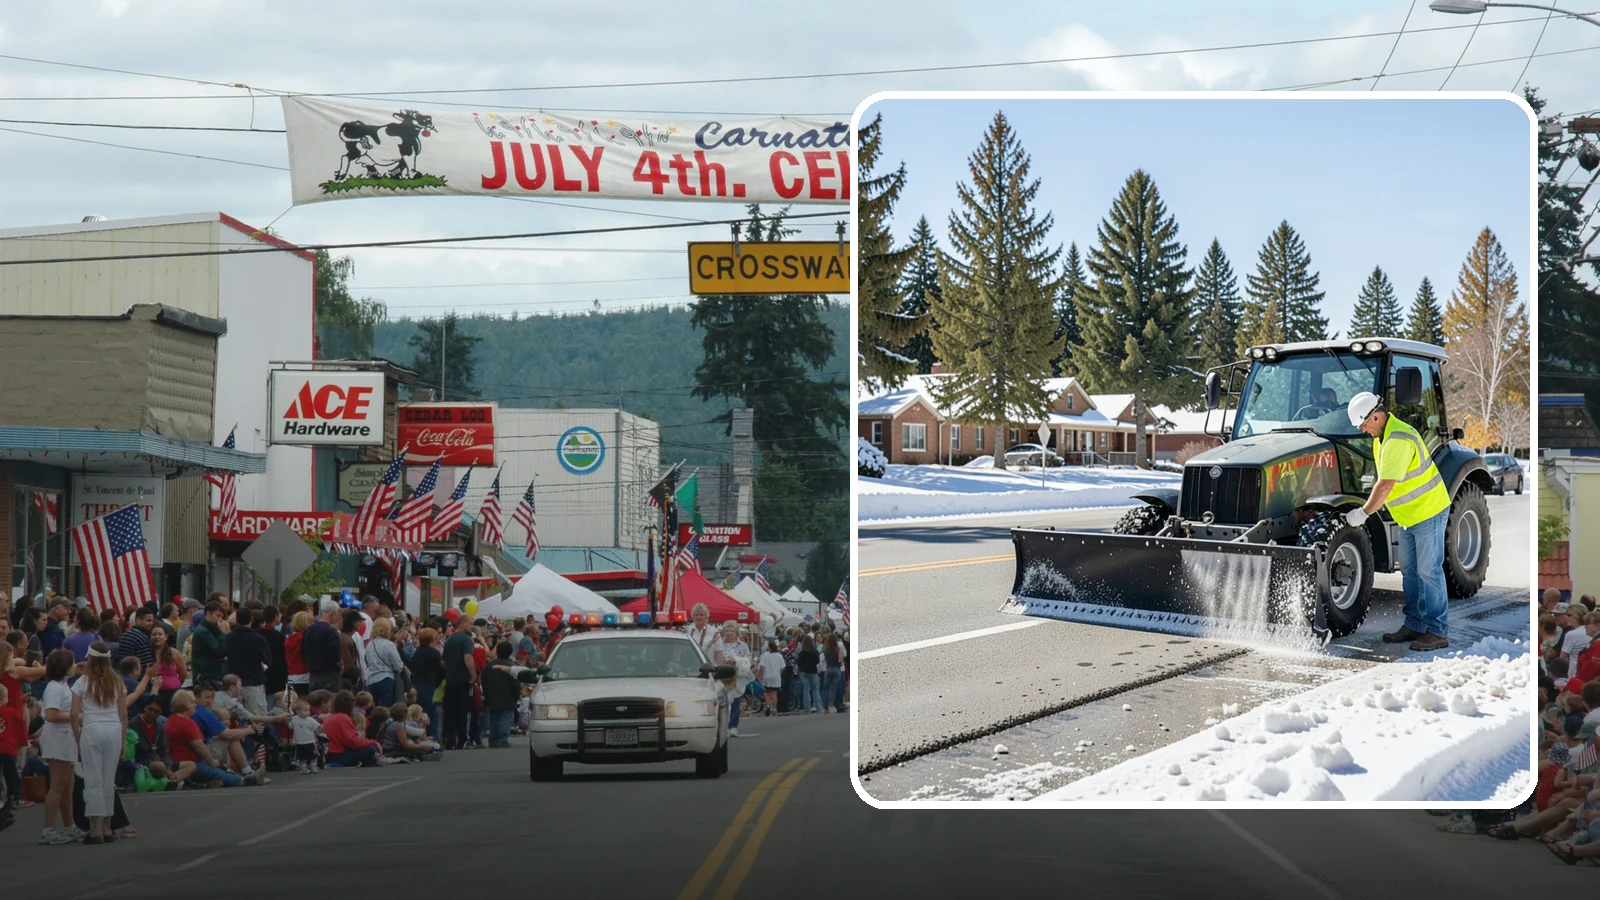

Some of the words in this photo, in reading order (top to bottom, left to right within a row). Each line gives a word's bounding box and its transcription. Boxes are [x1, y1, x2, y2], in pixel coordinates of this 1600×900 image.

[695, 122, 850, 149] Carnat
[481, 141, 605, 192] JULY
[632, 150, 746, 197] 4th.
[697, 254, 850, 280] CROSSWA
[283, 380, 373, 420] ACE
[406, 409, 452, 422] CEDAR
[283, 421, 370, 436] Hardware
[416, 428, 476, 447] Coca-Cola
[95, 485, 124, 495] Vincent
[126, 486, 136, 495] de
[137, 486, 155, 495] Paul
[699, 535, 730, 543] GLASS
